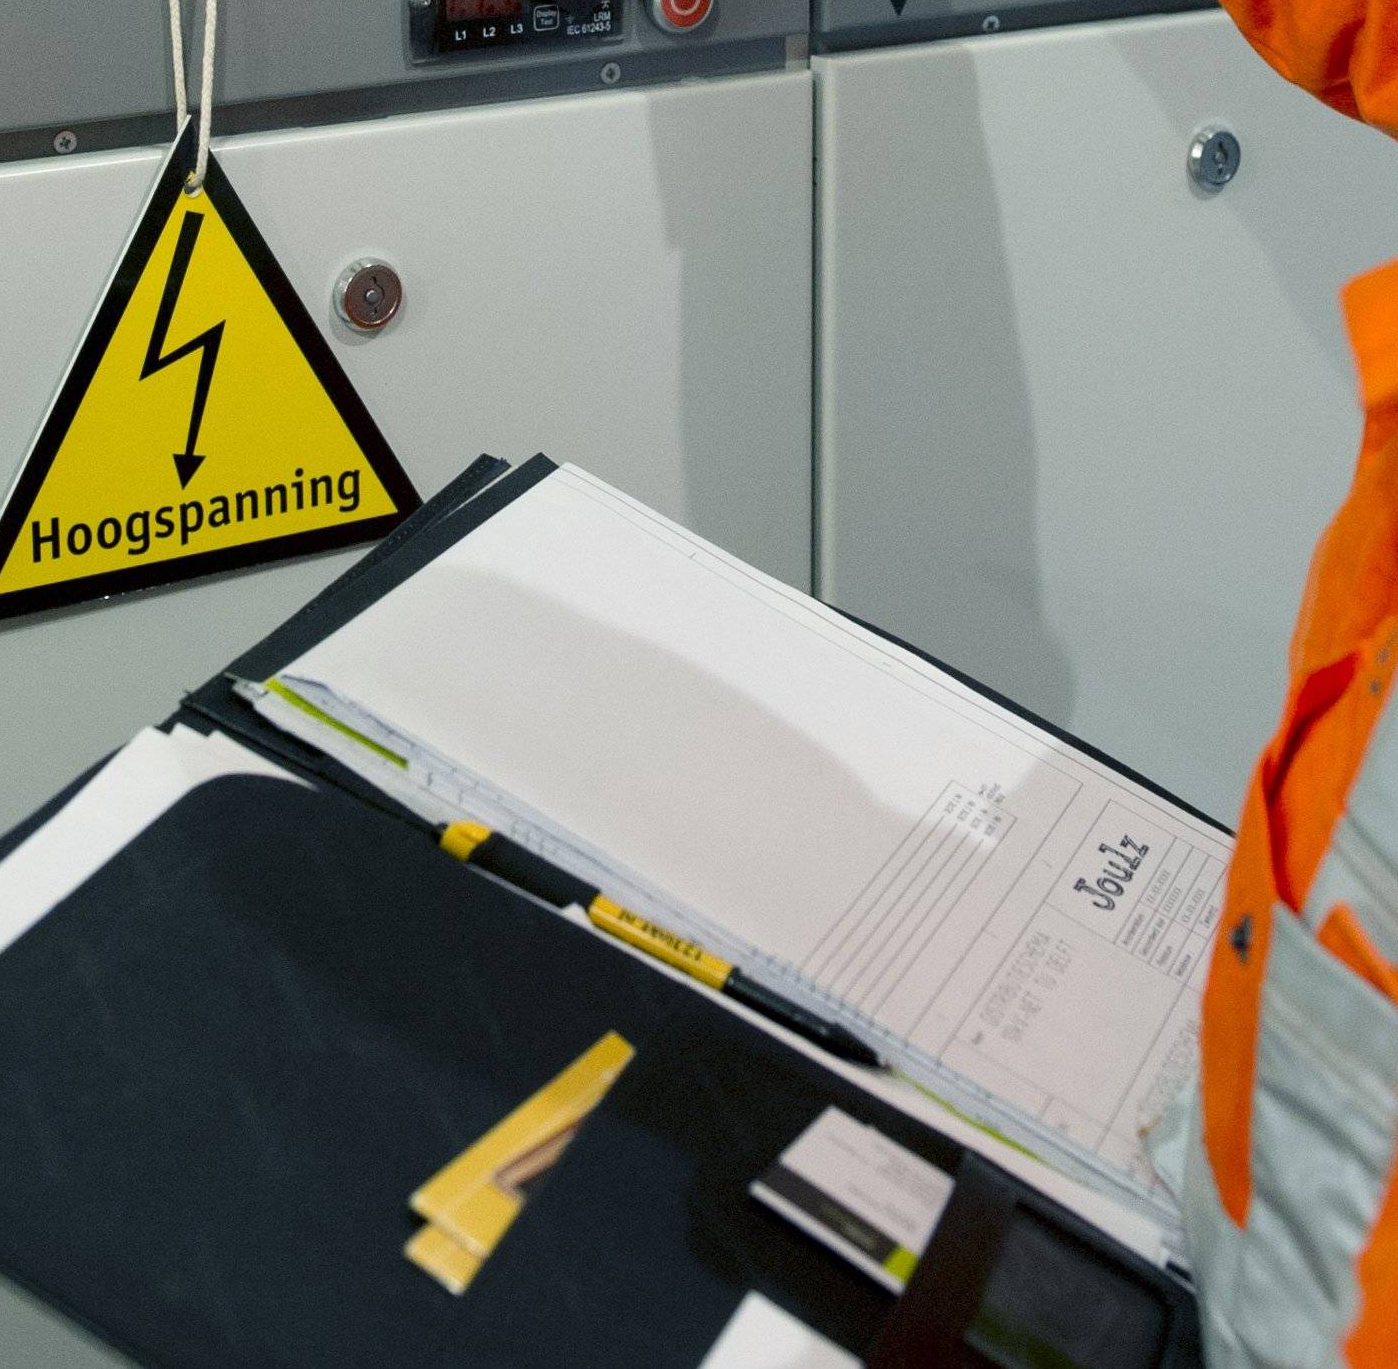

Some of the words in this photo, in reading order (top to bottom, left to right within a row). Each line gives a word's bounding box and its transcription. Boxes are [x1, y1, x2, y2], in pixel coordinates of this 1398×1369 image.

[455, 30, 467, 41] L1
[483, 27, 496, 38] L2
[510, 23, 524, 35] L3
[32, 467, 361, 563] Hoogspanning
[1073, 835, 1150, 912] Joulz
